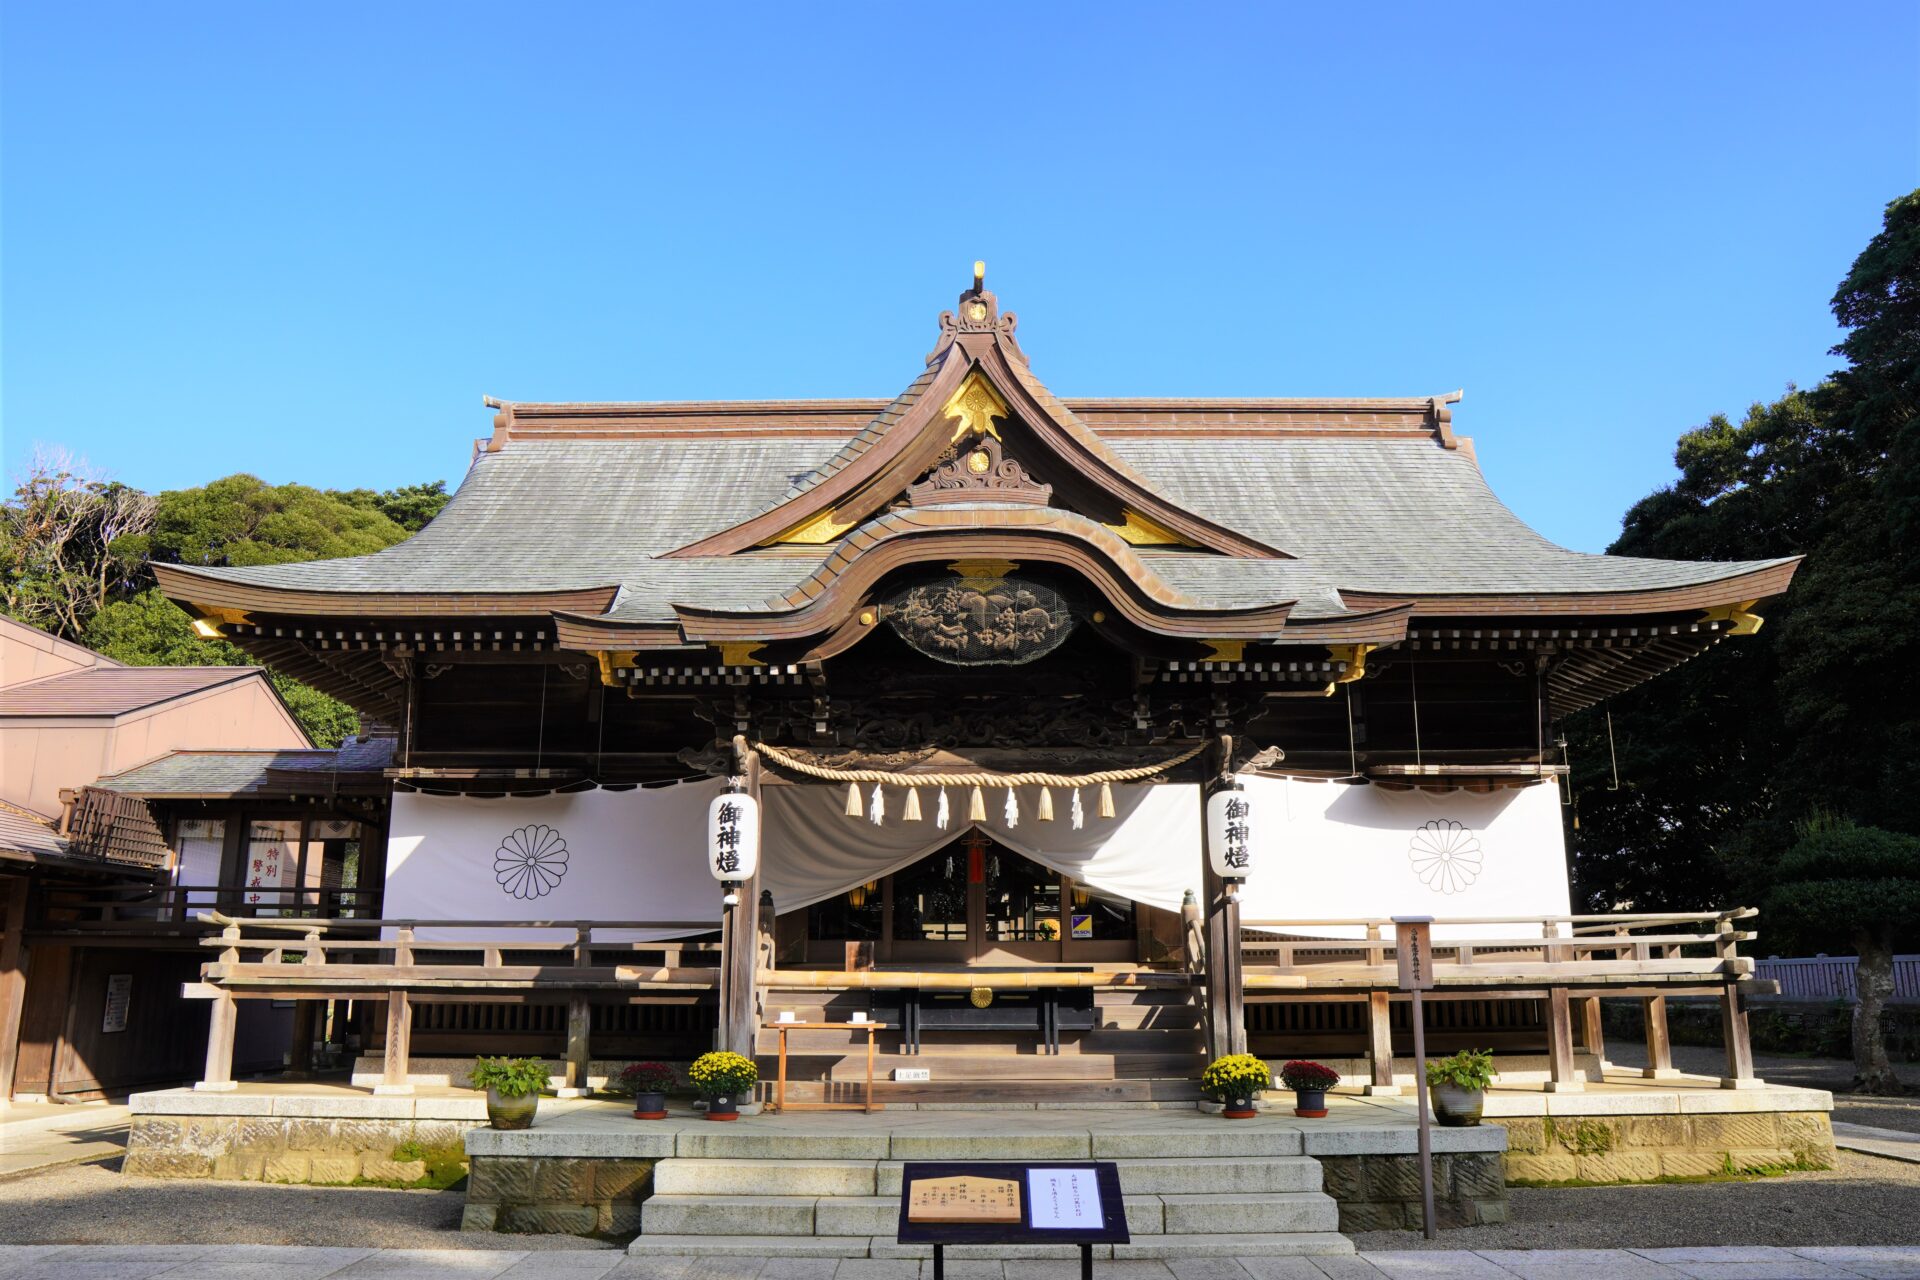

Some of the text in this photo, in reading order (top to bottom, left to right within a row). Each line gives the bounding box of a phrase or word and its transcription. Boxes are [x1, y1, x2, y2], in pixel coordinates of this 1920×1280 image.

[266, 847, 280, 878] 特別
[716, 801, 744, 874] 御神燈
[1224, 797, 1250, 869] 御神燈
